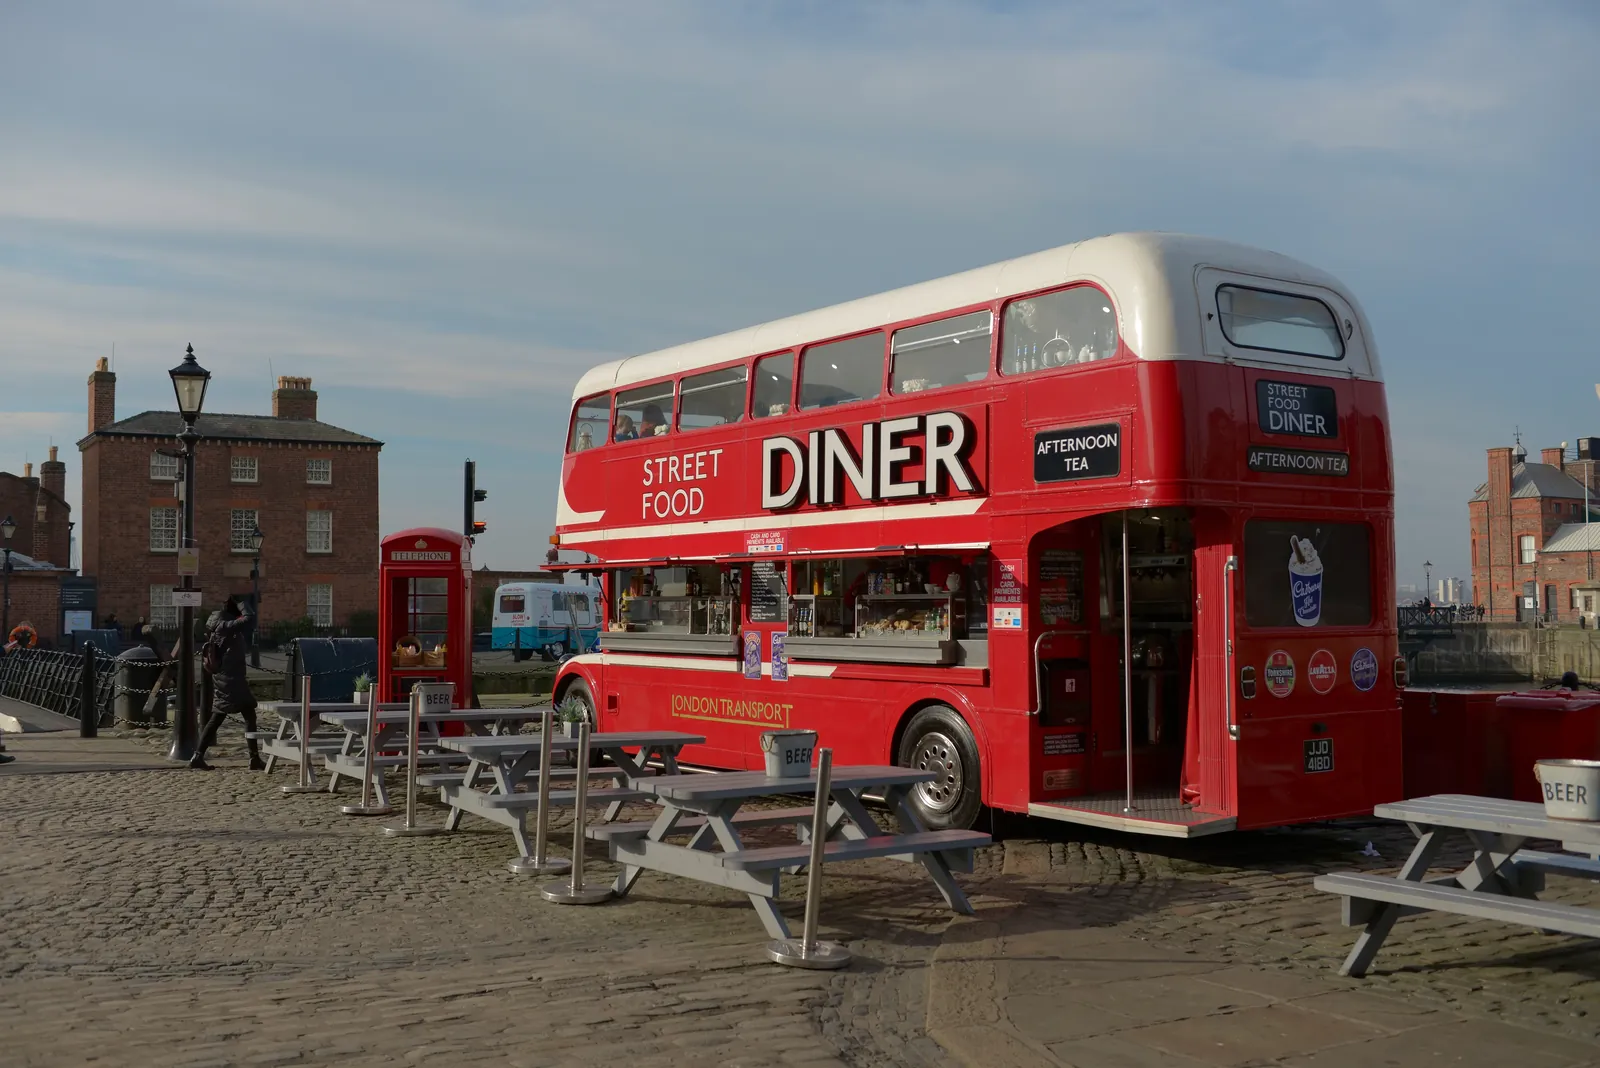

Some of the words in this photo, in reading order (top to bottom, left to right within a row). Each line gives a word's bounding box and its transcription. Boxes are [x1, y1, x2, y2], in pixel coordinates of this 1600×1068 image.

[1267, 383, 1308, 398] STREET
[1268, 396, 1300, 411] FOOD
[1269, 410, 1328, 435] DINER
[1037, 433, 1118, 455] AFTERNOON
[642, 448, 723, 486] STREET
[761, 411, 977, 510] DINER
[1064, 456, 1089, 472] TEA
[1249, 451, 1324, 470] AFTERNOON
[1326, 457, 1348, 471] TEA
[642, 487, 704, 520] FOOD
[393, 552, 449, 560] TELEPHONE
[1293, 580, 1321, 598] Cadbury
[995, 595, 1021, 603] AVAILABLE
[1267, 668, 1292, 677] YORKSHIRE
[1309, 664, 1336, 675] LAVAZZA
[1275, 676, 1285, 684] TEA
[426, 693, 450, 705] BEER
[671, 694, 718, 717] LONDON
[719, 699, 794, 729] TRANSPORT
[785, 747, 812, 765] BEER
[1308, 741, 1329, 755] JJD
[1544, 782, 1587, 805] BEER
